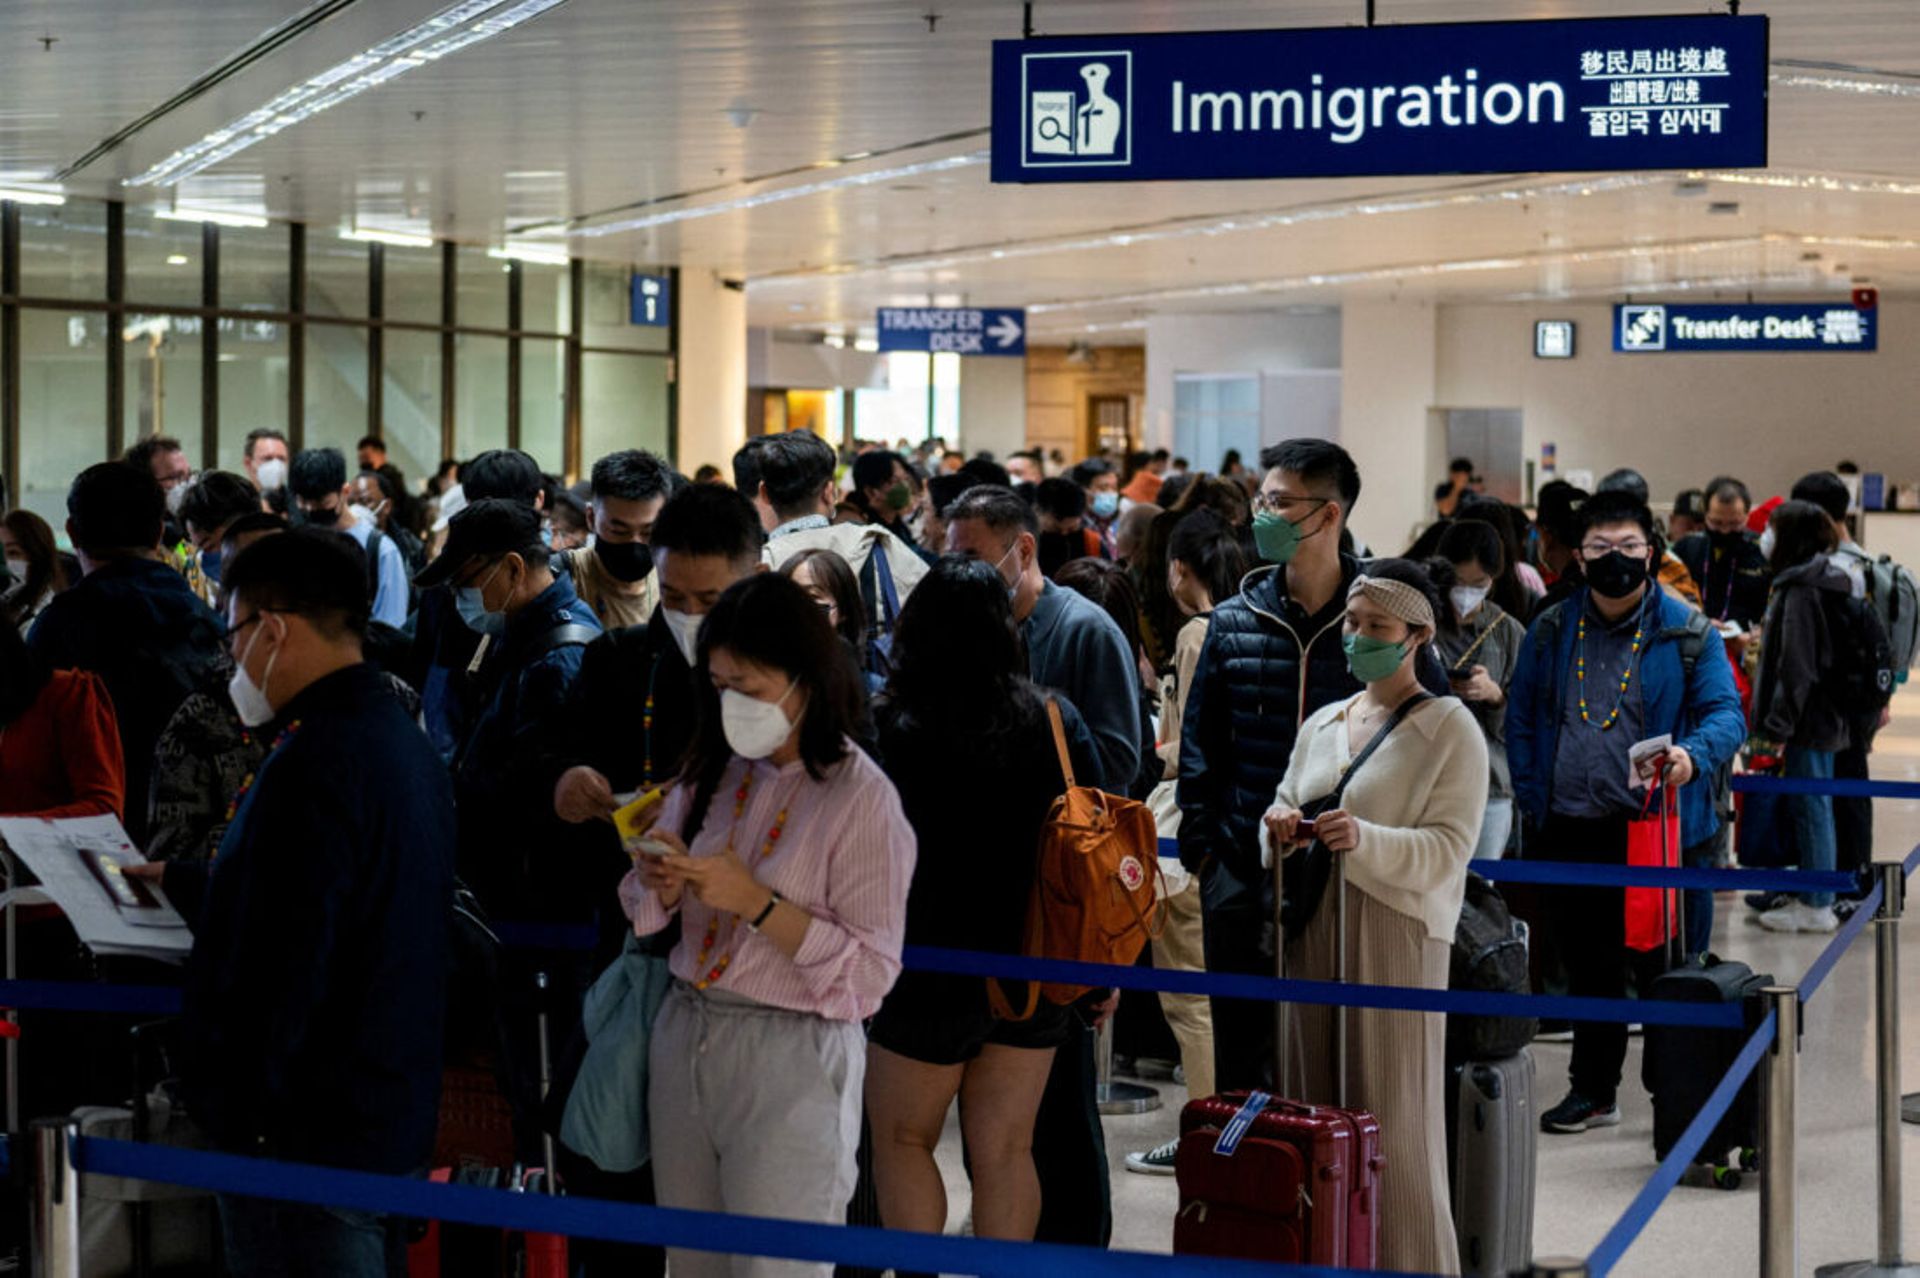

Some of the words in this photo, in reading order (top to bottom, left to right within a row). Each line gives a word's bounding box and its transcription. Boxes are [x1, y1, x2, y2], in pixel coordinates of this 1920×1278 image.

[1580, 46, 1727, 75] 移民局出境處
[1171, 69, 1565, 144] Immigration
[1589, 111, 1650, 137] 출입국
[1659, 109, 1722, 135] 심사대
[882, 309, 984, 330] TRANSFER
[1671, 315, 1761, 339] Transfer
[1763, 315, 1816, 339] Desk
[929, 331, 984, 352] DESK
